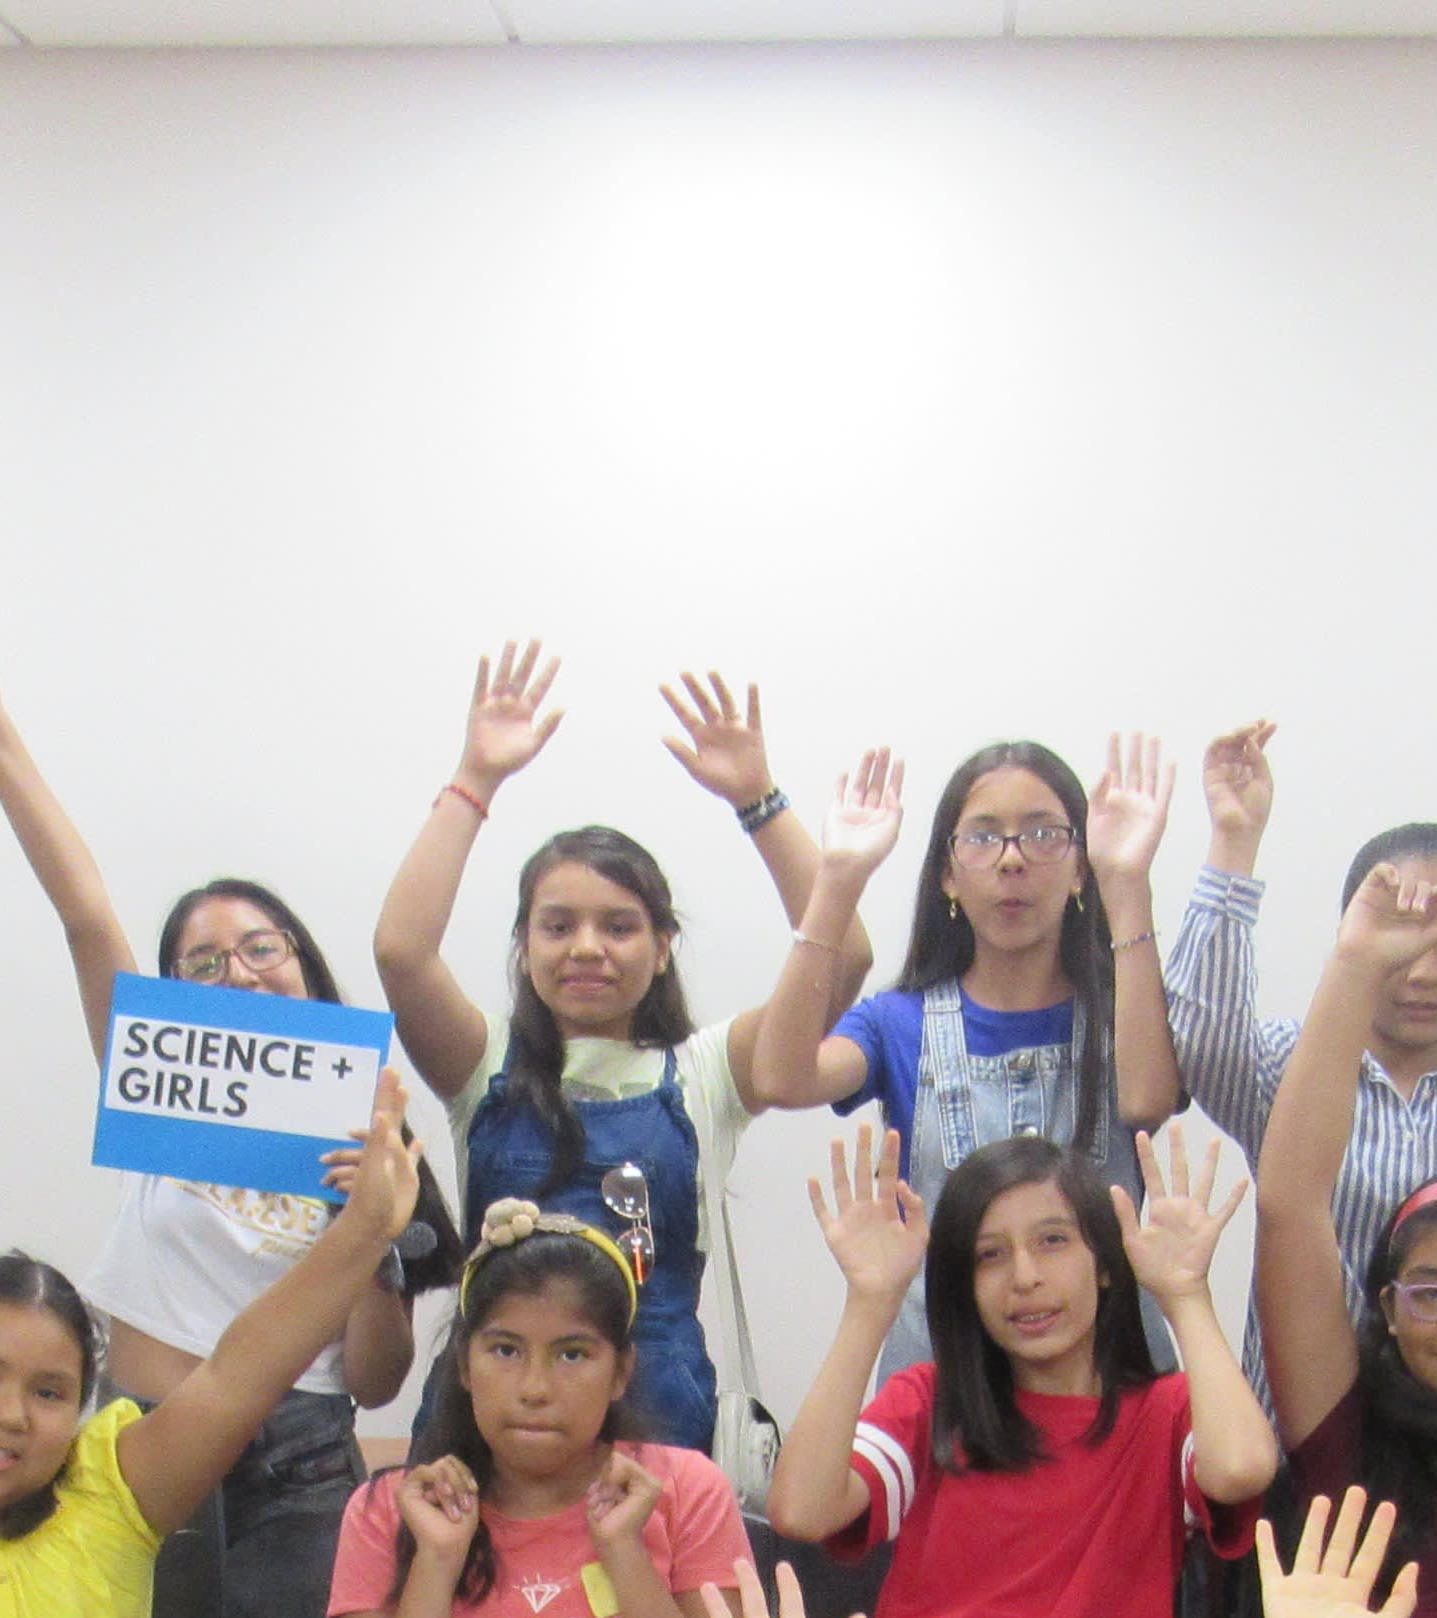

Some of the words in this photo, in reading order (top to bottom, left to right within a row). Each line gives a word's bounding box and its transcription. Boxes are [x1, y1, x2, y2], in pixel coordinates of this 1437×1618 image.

[123, 1021, 317, 1081] SCIENCE
[331, 1057, 353, 1079] +
[118, 1066, 250, 1118] GIRLS
